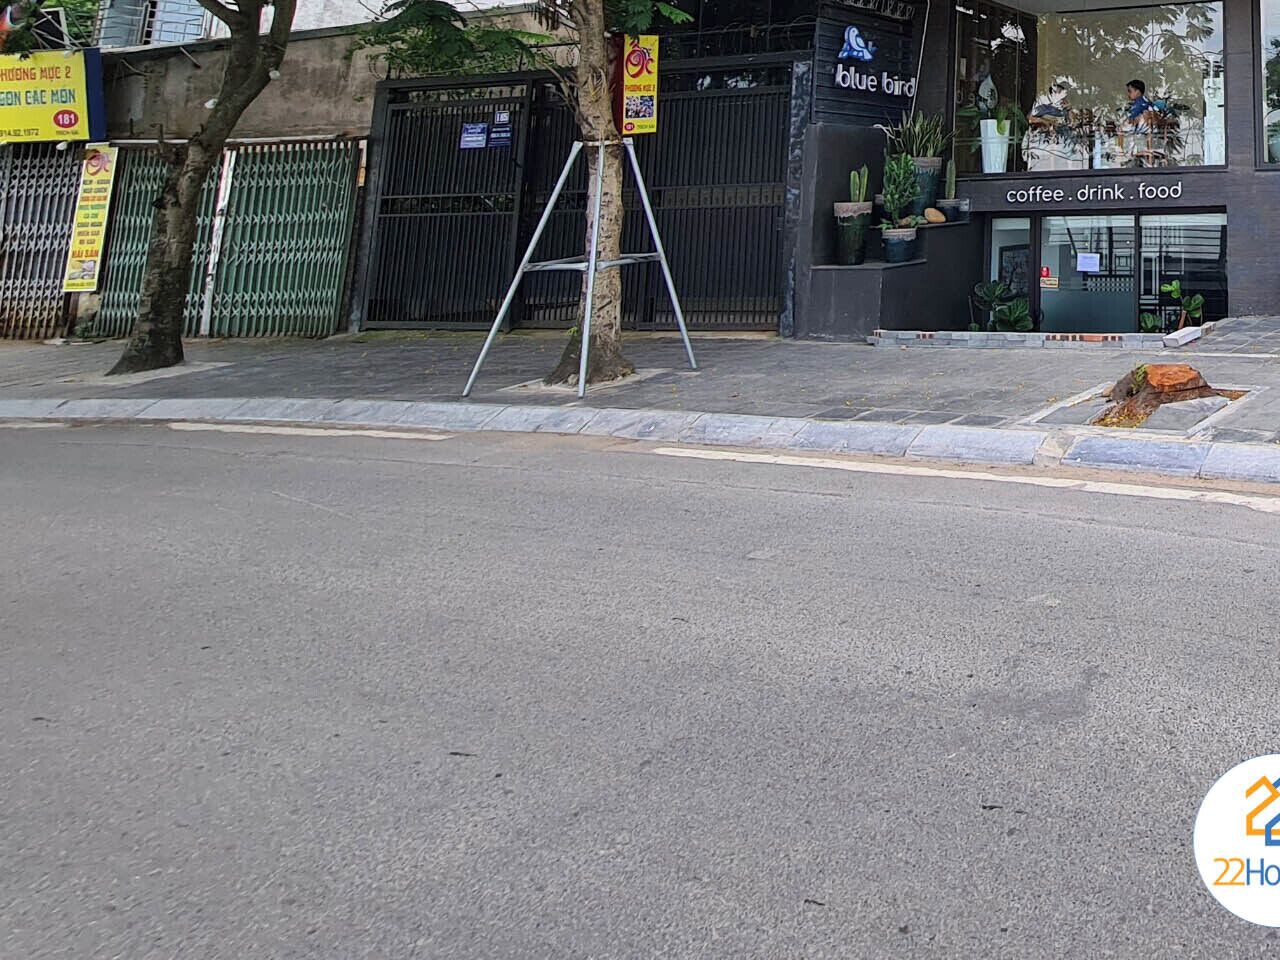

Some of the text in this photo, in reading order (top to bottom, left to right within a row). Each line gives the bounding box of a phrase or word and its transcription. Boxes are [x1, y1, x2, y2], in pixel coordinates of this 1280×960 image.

[0, 67, 36, 81] HƯƠNG
[65, 65, 71, 79] 2
[835, 63, 916, 97] blue bird
[56, 113, 75, 125] 181
[1006, 181, 1182, 202] coffee drink food
